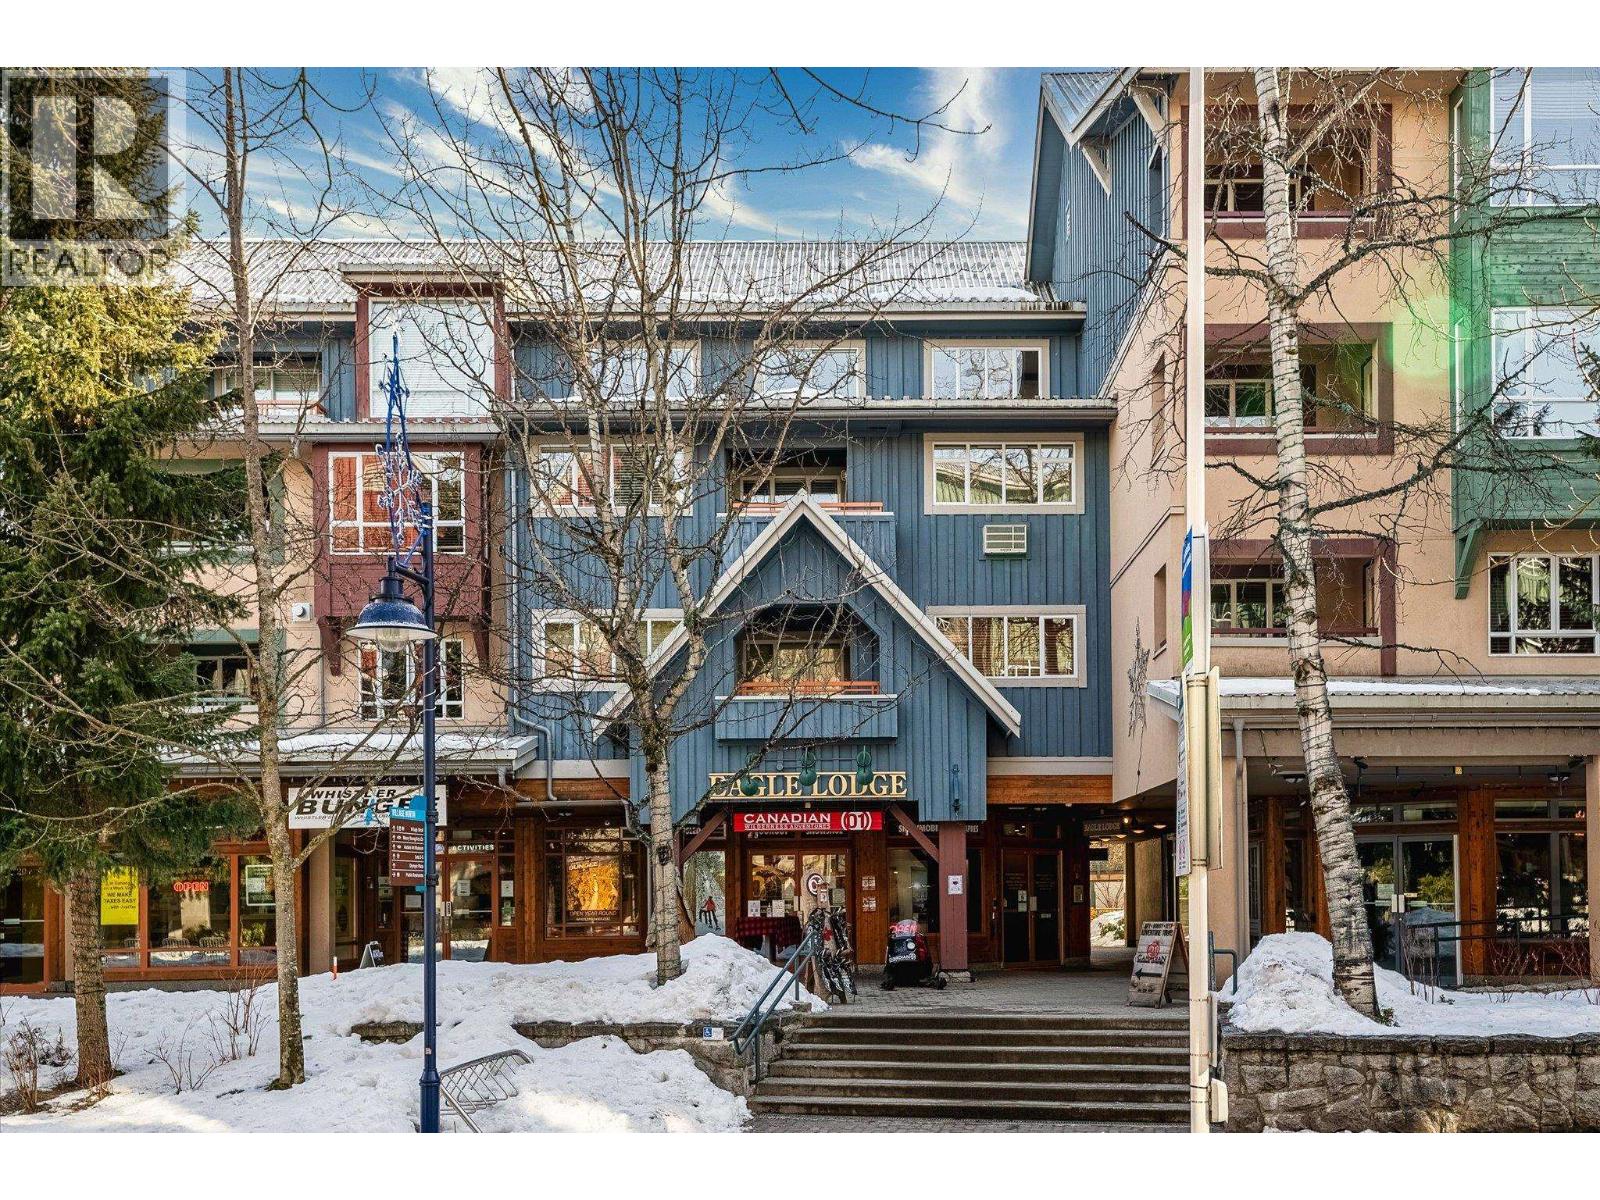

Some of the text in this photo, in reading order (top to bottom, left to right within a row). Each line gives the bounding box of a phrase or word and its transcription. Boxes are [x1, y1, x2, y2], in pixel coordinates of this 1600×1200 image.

[708, 774, 907, 796] EAGLE LODGE
[296, 797, 440, 815] BUNGE
[743, 813, 831, 824] CANADIAN
[453, 844, 494, 852] ACTIVITIES
[174, 881, 209, 892] OPEN
